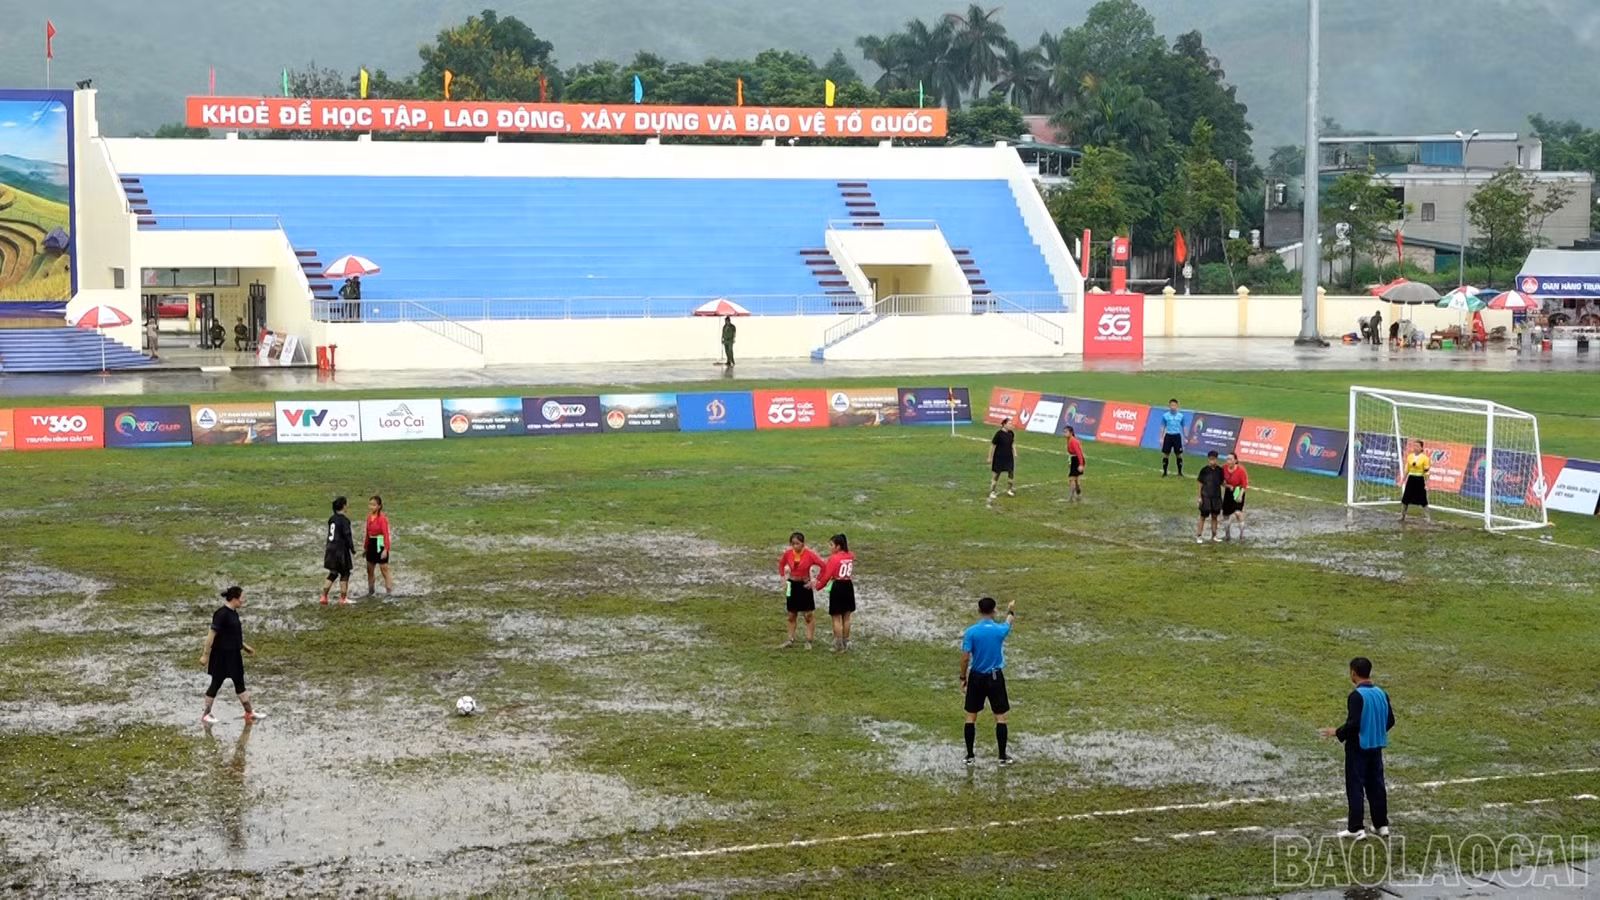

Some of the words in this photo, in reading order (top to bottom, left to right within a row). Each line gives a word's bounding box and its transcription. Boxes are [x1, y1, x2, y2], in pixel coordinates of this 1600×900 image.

[202, 100, 269, 124] KHOẺ
[279, 99, 312, 125] ĐỂ
[322, 106, 372, 129] HỌC
[381, 104, 433, 130] TẬP,
[444, 109, 488, 127] LAO
[496, 106, 571, 131] ĐỘNG,
[581, 108, 626, 129] XÂY
[634, 111, 699, 133] DỰNG
[707, 109, 736, 131] VÀ
[745, 109, 790, 132] BẢO
[798, 111, 826, 135] VỆ
[835, 109, 863, 132] TỔ
[871, 109, 932, 133] QUỐC
[1098, 314, 1131, 336] 5G
[283, 409, 328, 427] VTV
[329, 417, 348, 431] go
[404, 416, 425, 427] Cai
[768, 404, 796, 424] 5G
[329, 522, 336, 541] 9
[839, 563, 853, 578] 08
